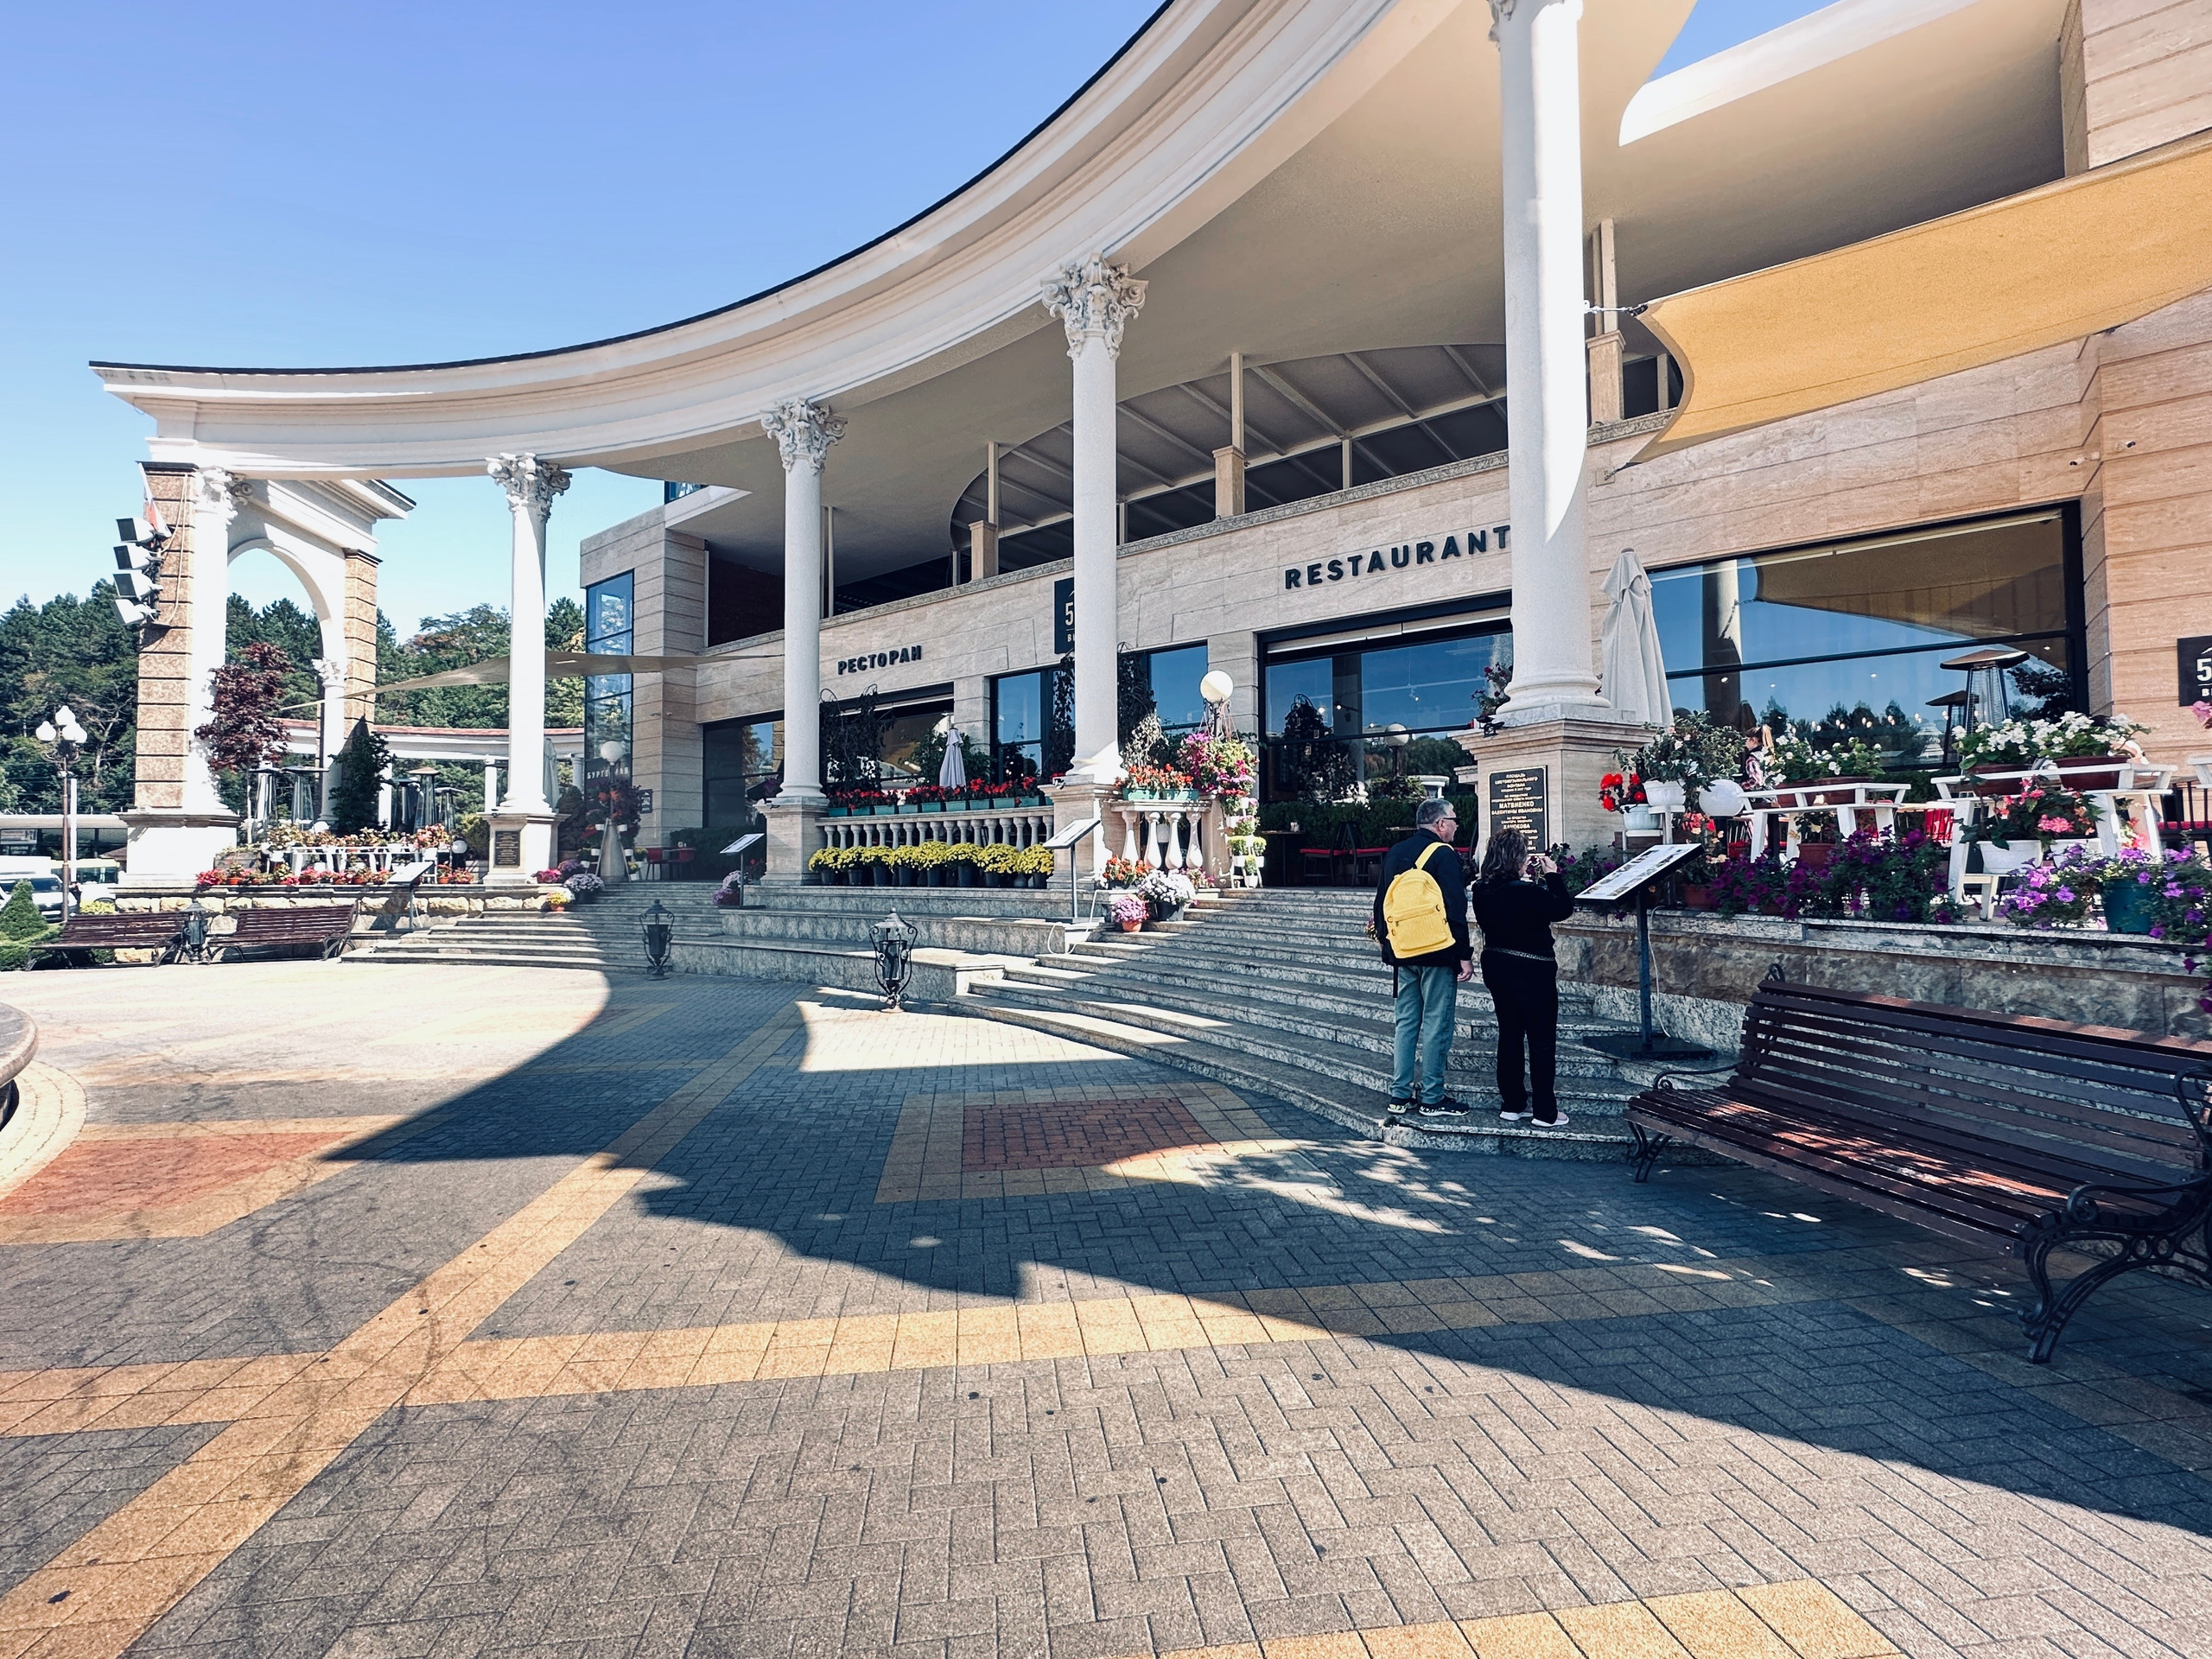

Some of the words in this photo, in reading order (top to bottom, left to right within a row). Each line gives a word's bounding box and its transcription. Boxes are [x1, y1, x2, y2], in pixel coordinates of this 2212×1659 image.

[1284, 524, 1511, 589] RESTAURANT
[837, 645, 922, 676] РЕСТОРАН
[587, 766, 629, 779] БУРГЕАЯ
